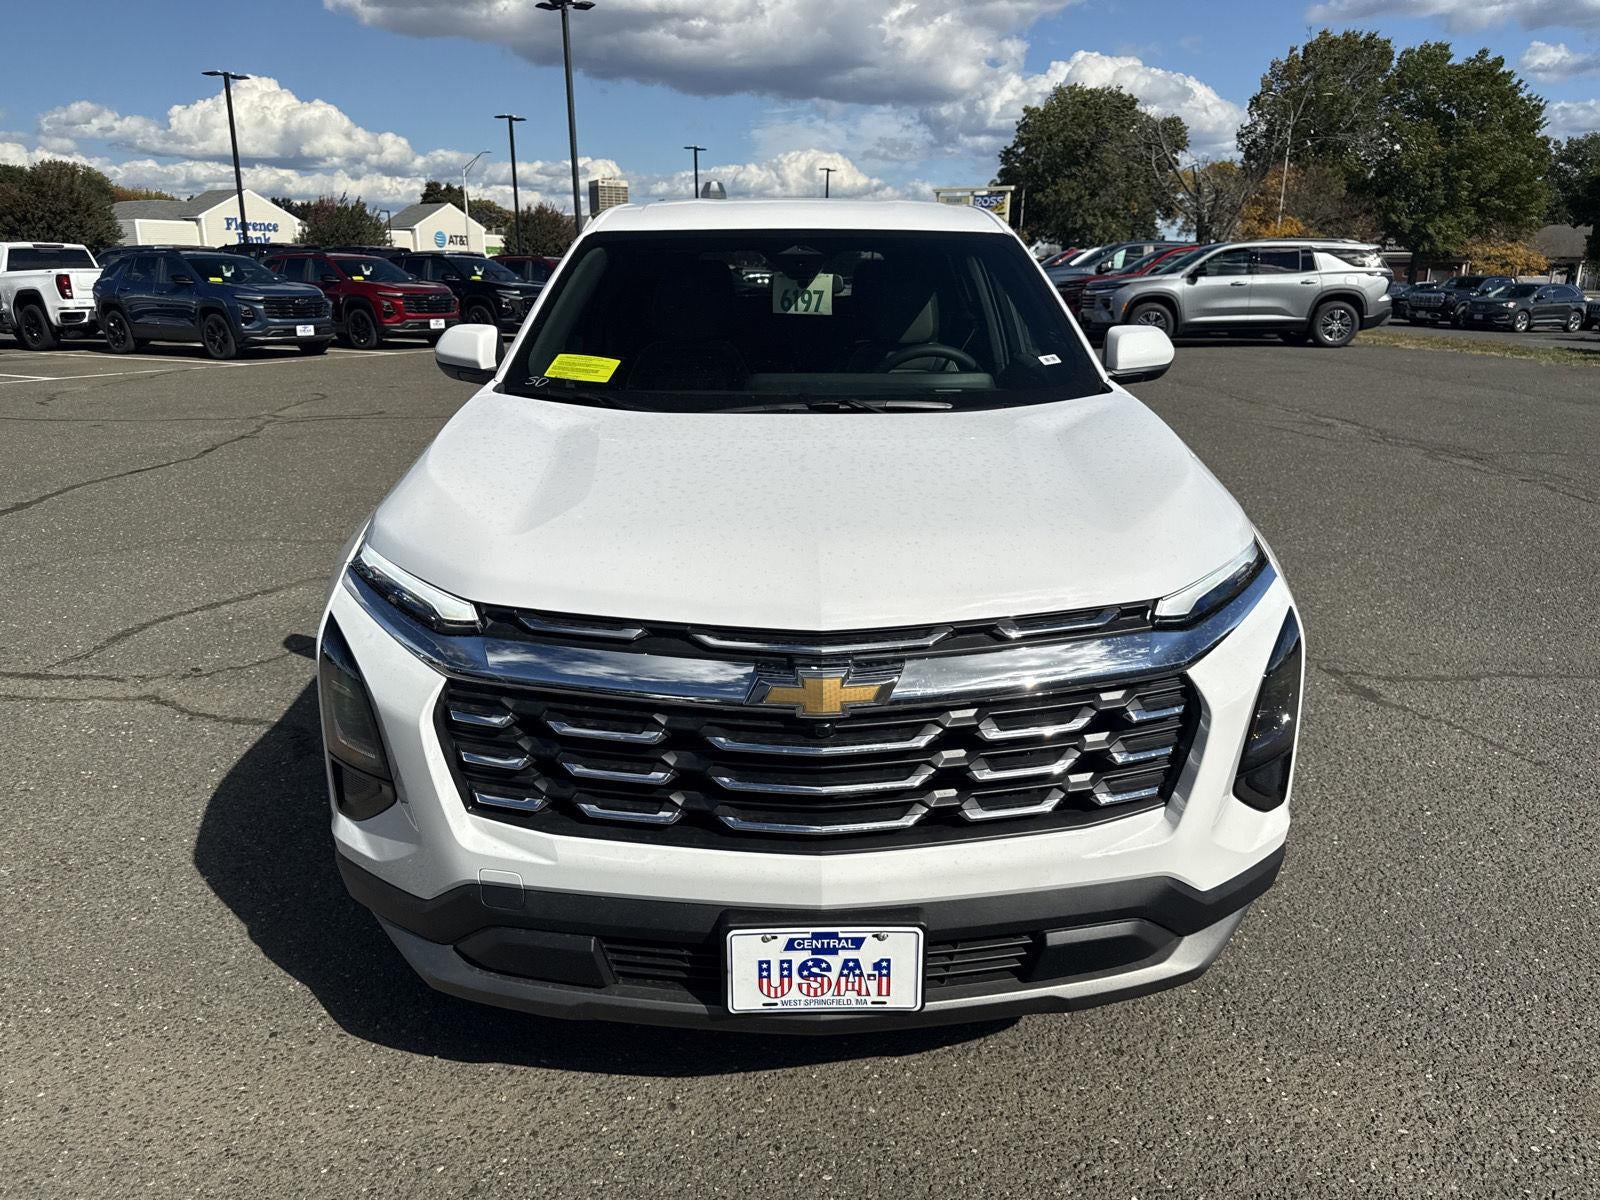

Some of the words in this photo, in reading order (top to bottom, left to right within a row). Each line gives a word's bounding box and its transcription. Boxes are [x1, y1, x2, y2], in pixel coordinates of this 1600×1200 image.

[224, 217, 279, 233] Florence
[448, 235, 470, 246] AT&T
[780, 289, 825, 313] 6197
[794, 939, 856, 949] CENTRAL
[758, 957, 891, 998] USA-1
[780, 999, 802, 1007] WEST
[855, 998, 868, 1006] MA
